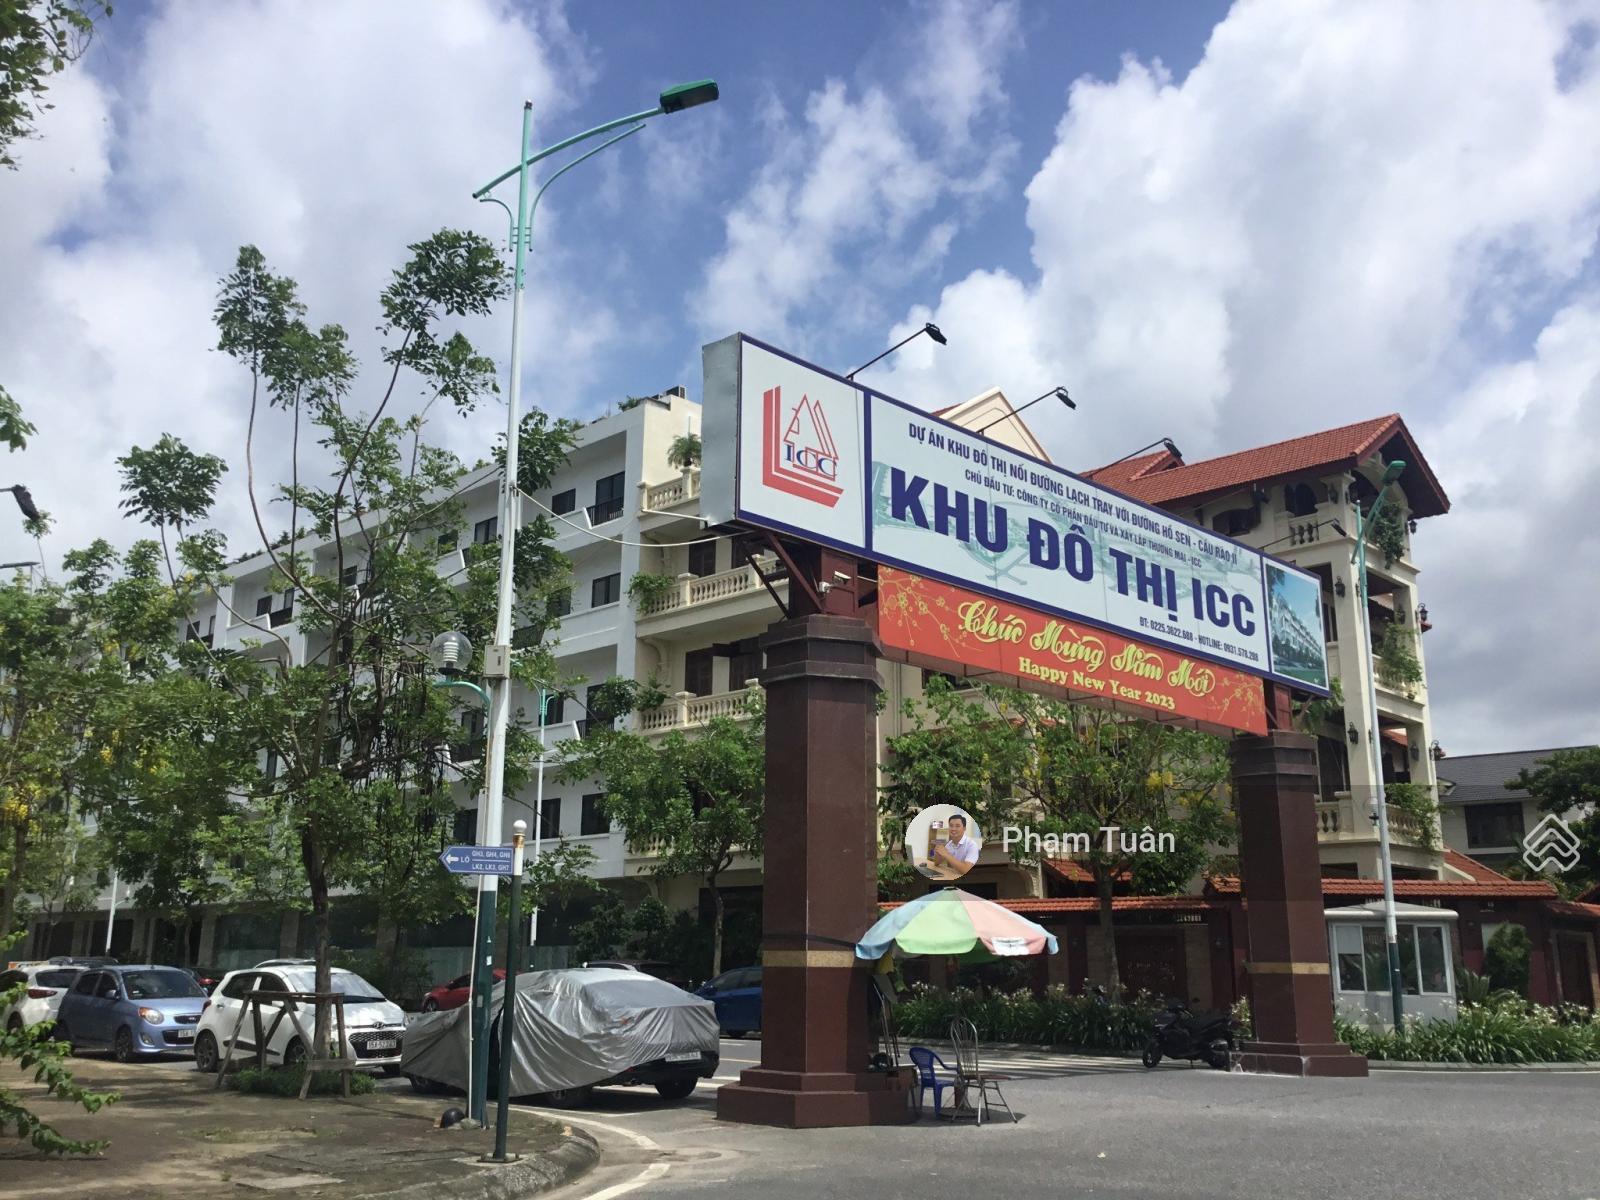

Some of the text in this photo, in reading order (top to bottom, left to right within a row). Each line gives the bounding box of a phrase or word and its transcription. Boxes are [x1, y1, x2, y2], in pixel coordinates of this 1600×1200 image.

[784, 443, 838, 477] ICC
[909, 422, 926, 445] DỰ
[928, 429, 944, 450] ÁN
[947, 438, 970, 460] KHU
[972, 448, 987, 466] ĐÔ
[990, 455, 1007, 478] THỊ
[1009, 463, 1028, 483] NỐI
[1030, 472, 1064, 497] ĐƯỜNG
[1066, 485, 1090, 507] LẠCH
[1092, 496, 1113, 517] TRAY
[1115, 505, 1129, 523] VỚI
[1131, 513, 1160, 535] ĐƯỜNG
[1175, 530, 1191, 547] SEN
[965, 468, 982, 485] CHỦ
[1016, 488, 1039, 505] CÔNG
[1040, 497, 1049, 510] TY
[890, 467, 1256, 637] KHU ĐÔ THỊ ICC
[957, 600, 1216, 697] Chúc Mừng Năm Mới
[1198, 634, 1223, 651] HOTLINE:
[1018, 657, 1176, 710] Happy New Year 2023
